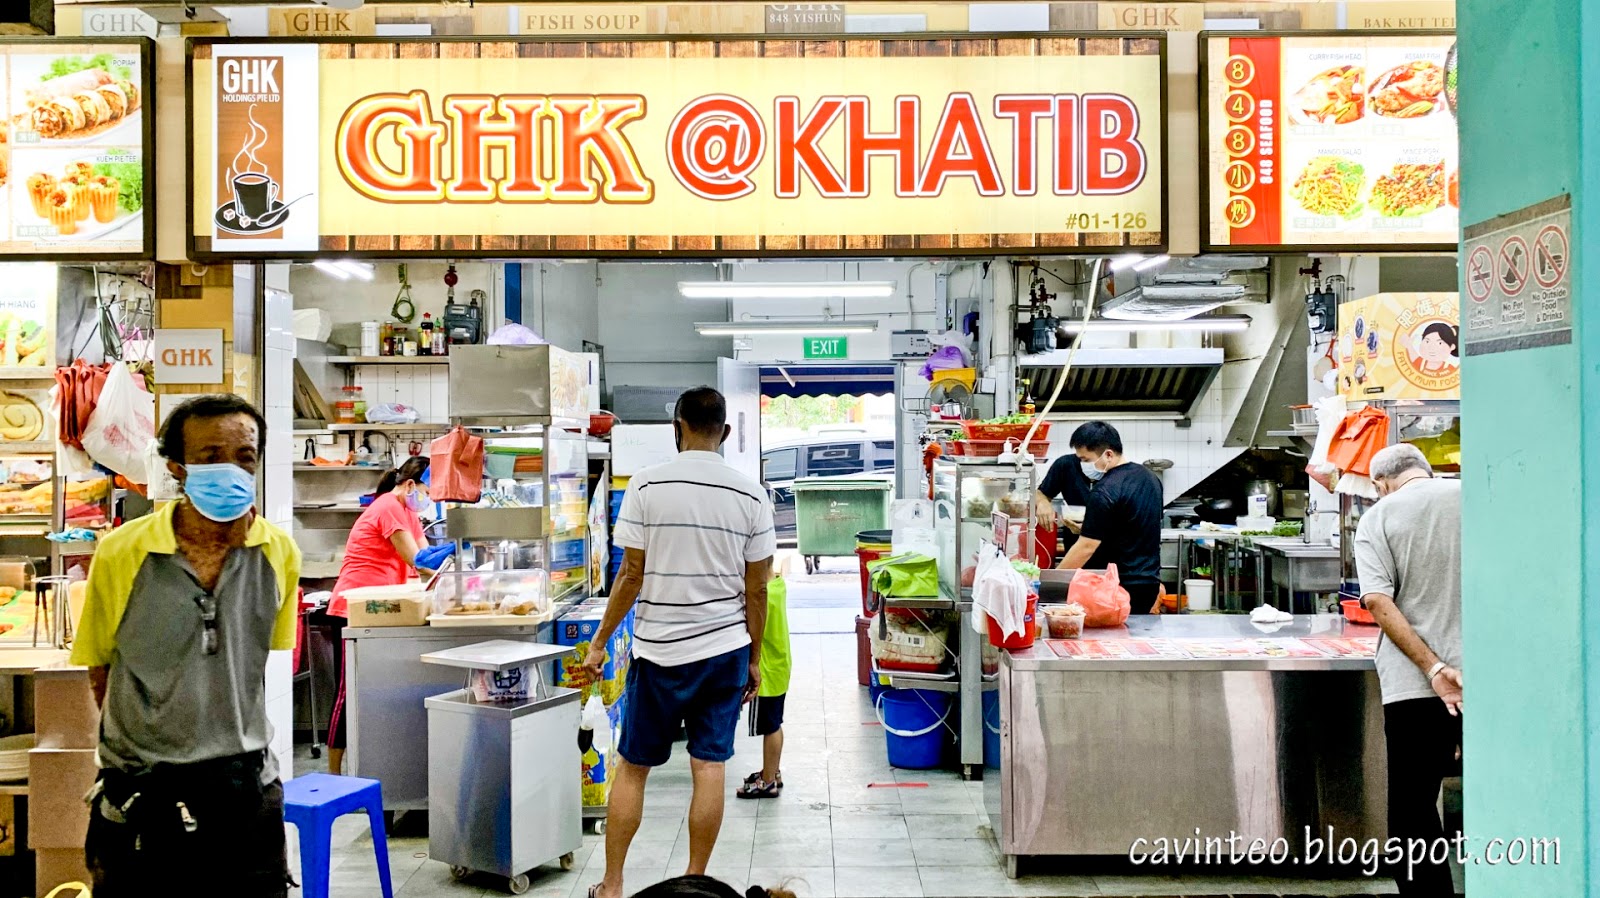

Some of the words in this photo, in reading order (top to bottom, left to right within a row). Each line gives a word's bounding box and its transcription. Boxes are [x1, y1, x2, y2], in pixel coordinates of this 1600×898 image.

[90, 13, 147, 32] GHK
[293, 12, 352, 32] GHK
[526, 14, 575, 30] FISH
[583, 14, 640, 30] SOUP
[769, 13, 789, 23] 848
[793, 13, 842, 23] YISHUN
[1122, 7, 1180, 26] GHK
[1363, 17, 1392, 28] BAK
[1398, 17, 1427, 28] KUT
[112, 59, 136, 67] POPIAH
[222, 58, 280, 94] GHK
[222, 94, 256, 103] HOLDINGS
[257, 94, 268, 103] PTE
[269, 94, 281, 103] LTD
[1259, 99, 1274, 156] SEAFOOD
[335, 89, 655, 205] GHK
[1259, 159, 1274, 184] 848
[1064, 211, 1148, 230] #01-126
[1531, 293, 1540, 302] No
[1541, 288, 1567, 301] Outside
[7, 300, 36, 309] HIANG
[1502, 303, 1511, 312] No
[1541, 301, 1557, 311] Food
[1501, 311, 1526, 323] Allowed
[1542, 311, 1563, 322] Drinks
[810, 340, 840, 356] EXIT
[161, 348, 214, 367] GHK
[1396, 350, 1415, 377] FATTY
[1414, 375, 1437, 388] MUM
